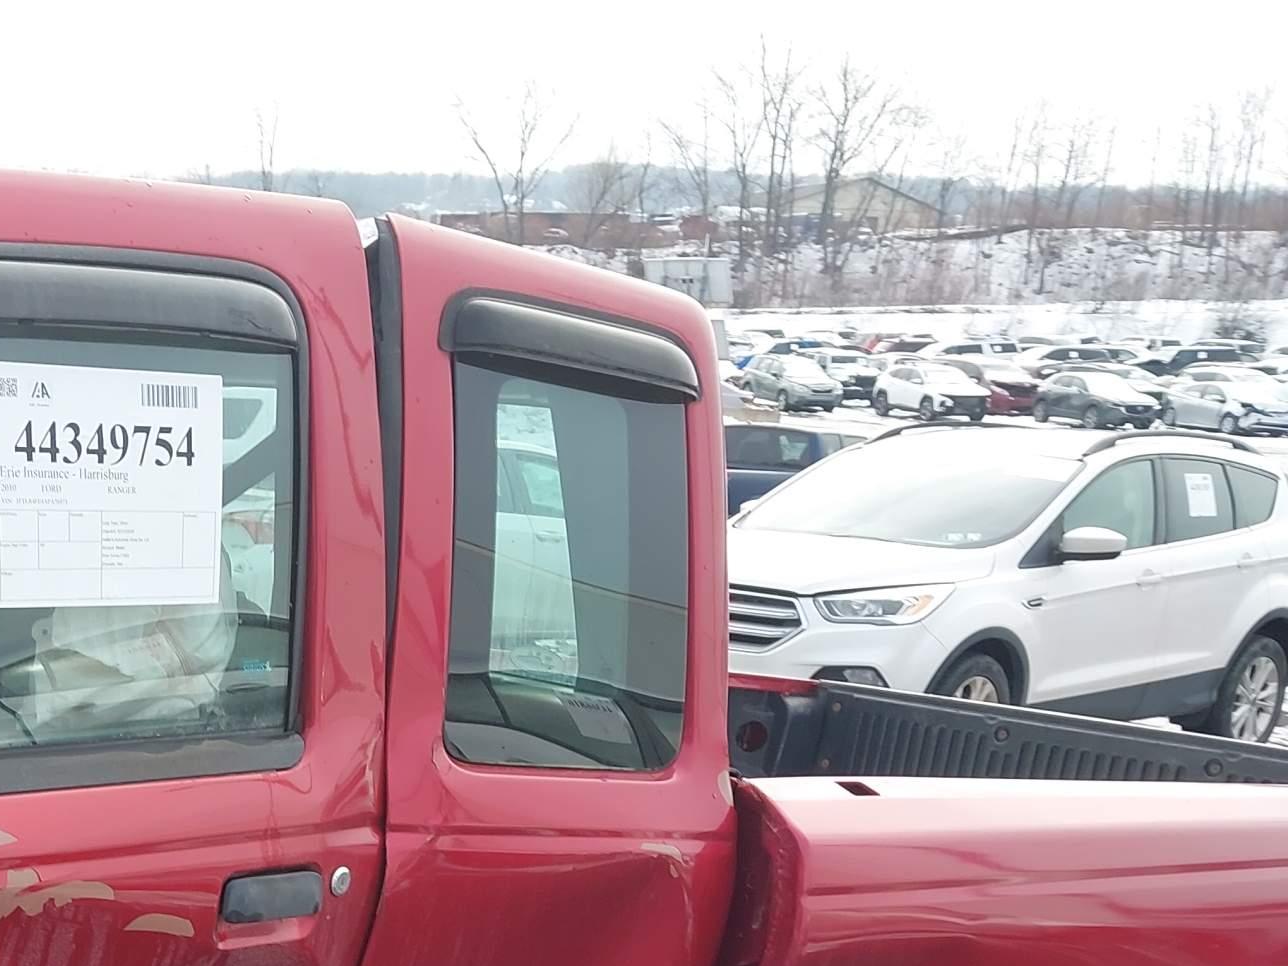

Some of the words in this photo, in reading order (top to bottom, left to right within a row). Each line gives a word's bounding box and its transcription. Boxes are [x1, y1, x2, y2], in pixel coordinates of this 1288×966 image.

[14, 420, 195, 467] 44349754
[0, 465, 20, 478] Erie
[24, 466, 70, 480] Insurance
[79, 468, 129, 483] Harrisburg
[107, 487, 137, 495] RANGER
